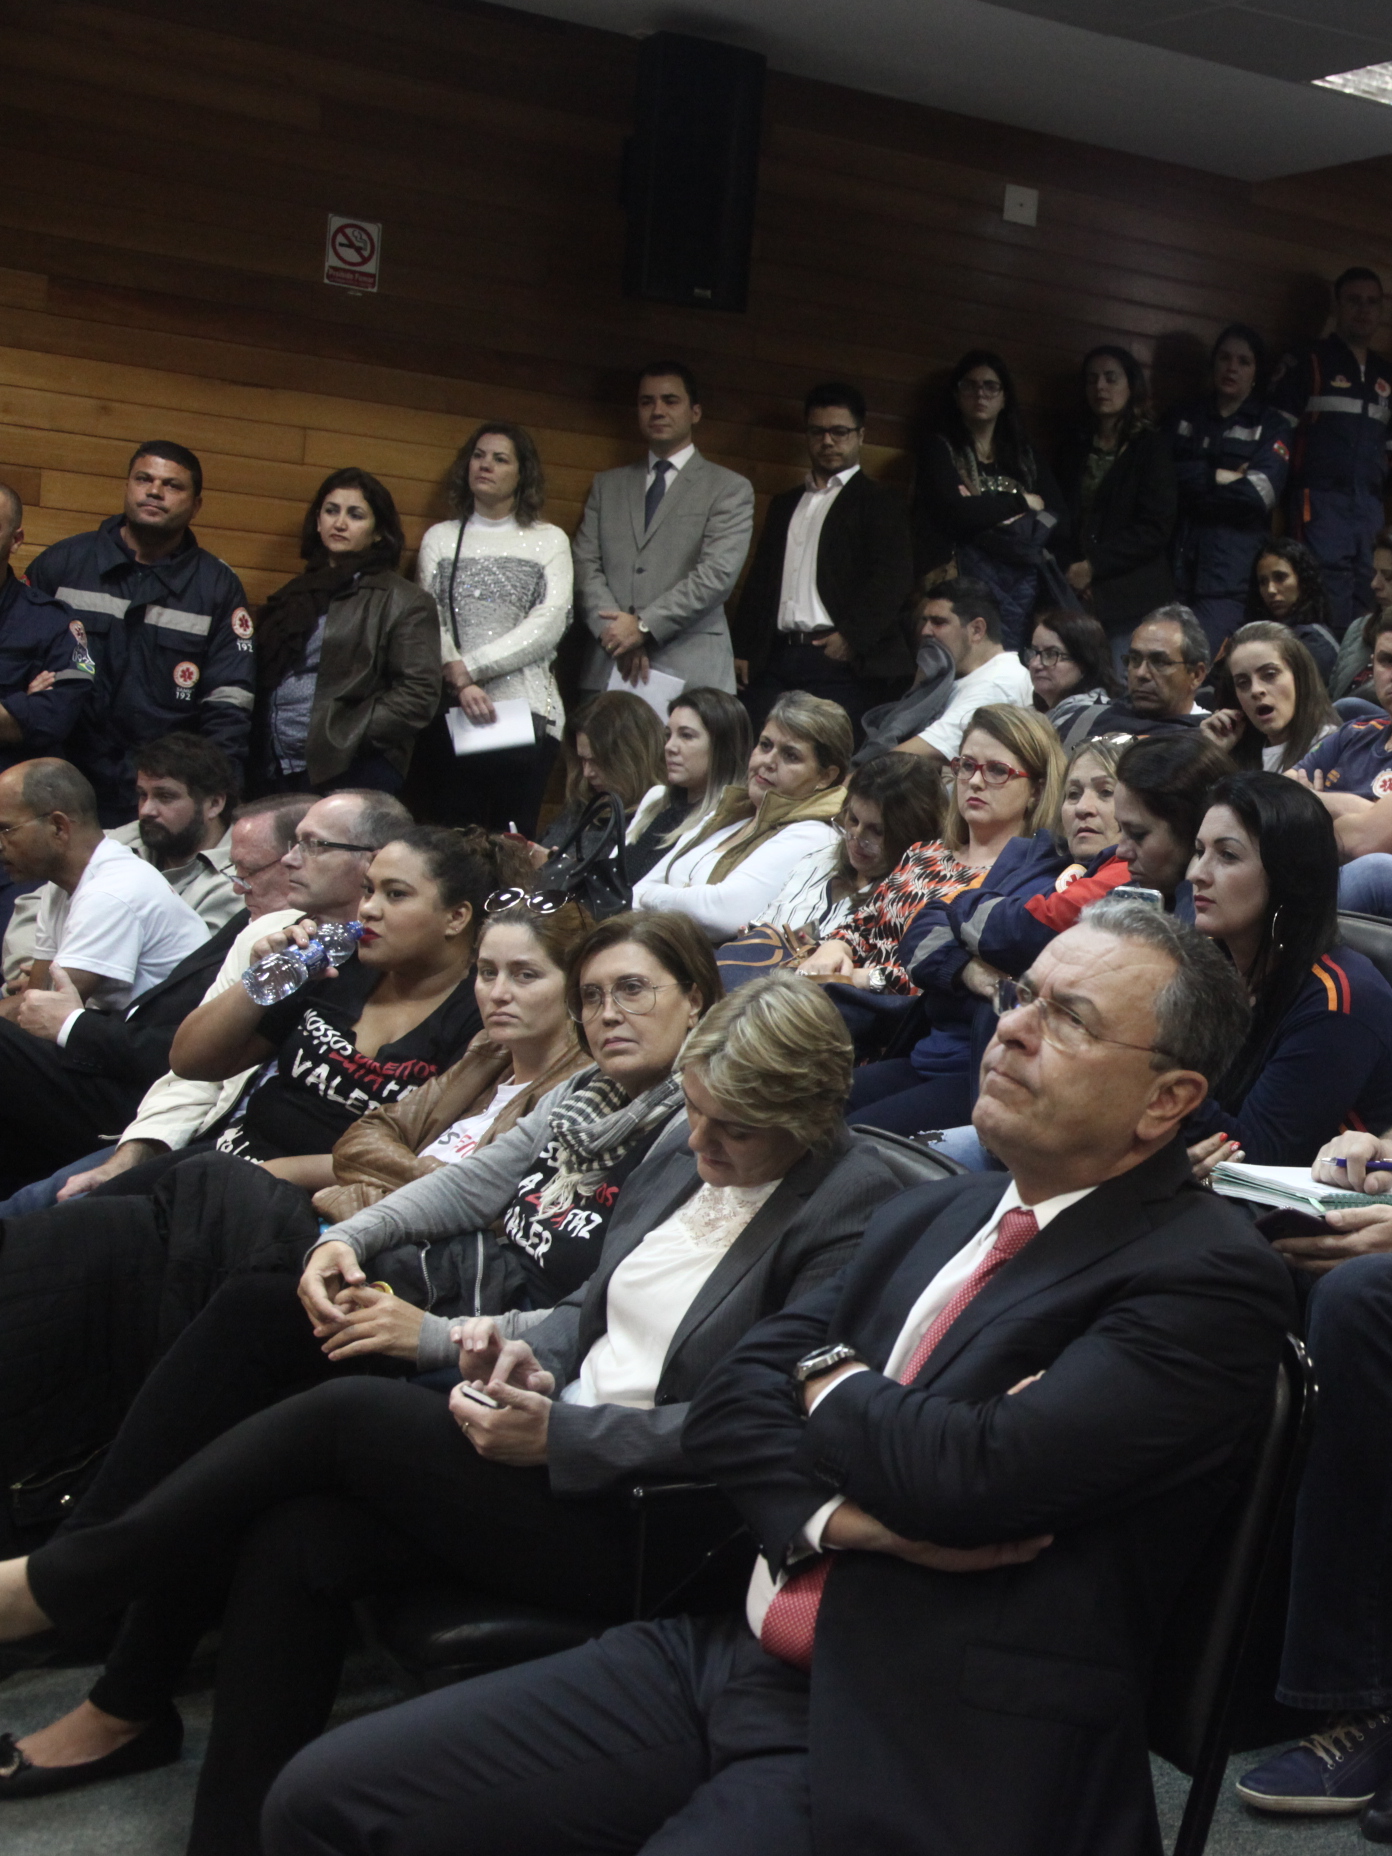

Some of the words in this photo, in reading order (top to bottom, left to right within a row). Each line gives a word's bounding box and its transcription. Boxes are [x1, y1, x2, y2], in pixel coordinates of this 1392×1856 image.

[237, 643, 254, 652] 192
[175, 691, 191, 700] 192
[558, 1208, 603, 1240] FAZ
